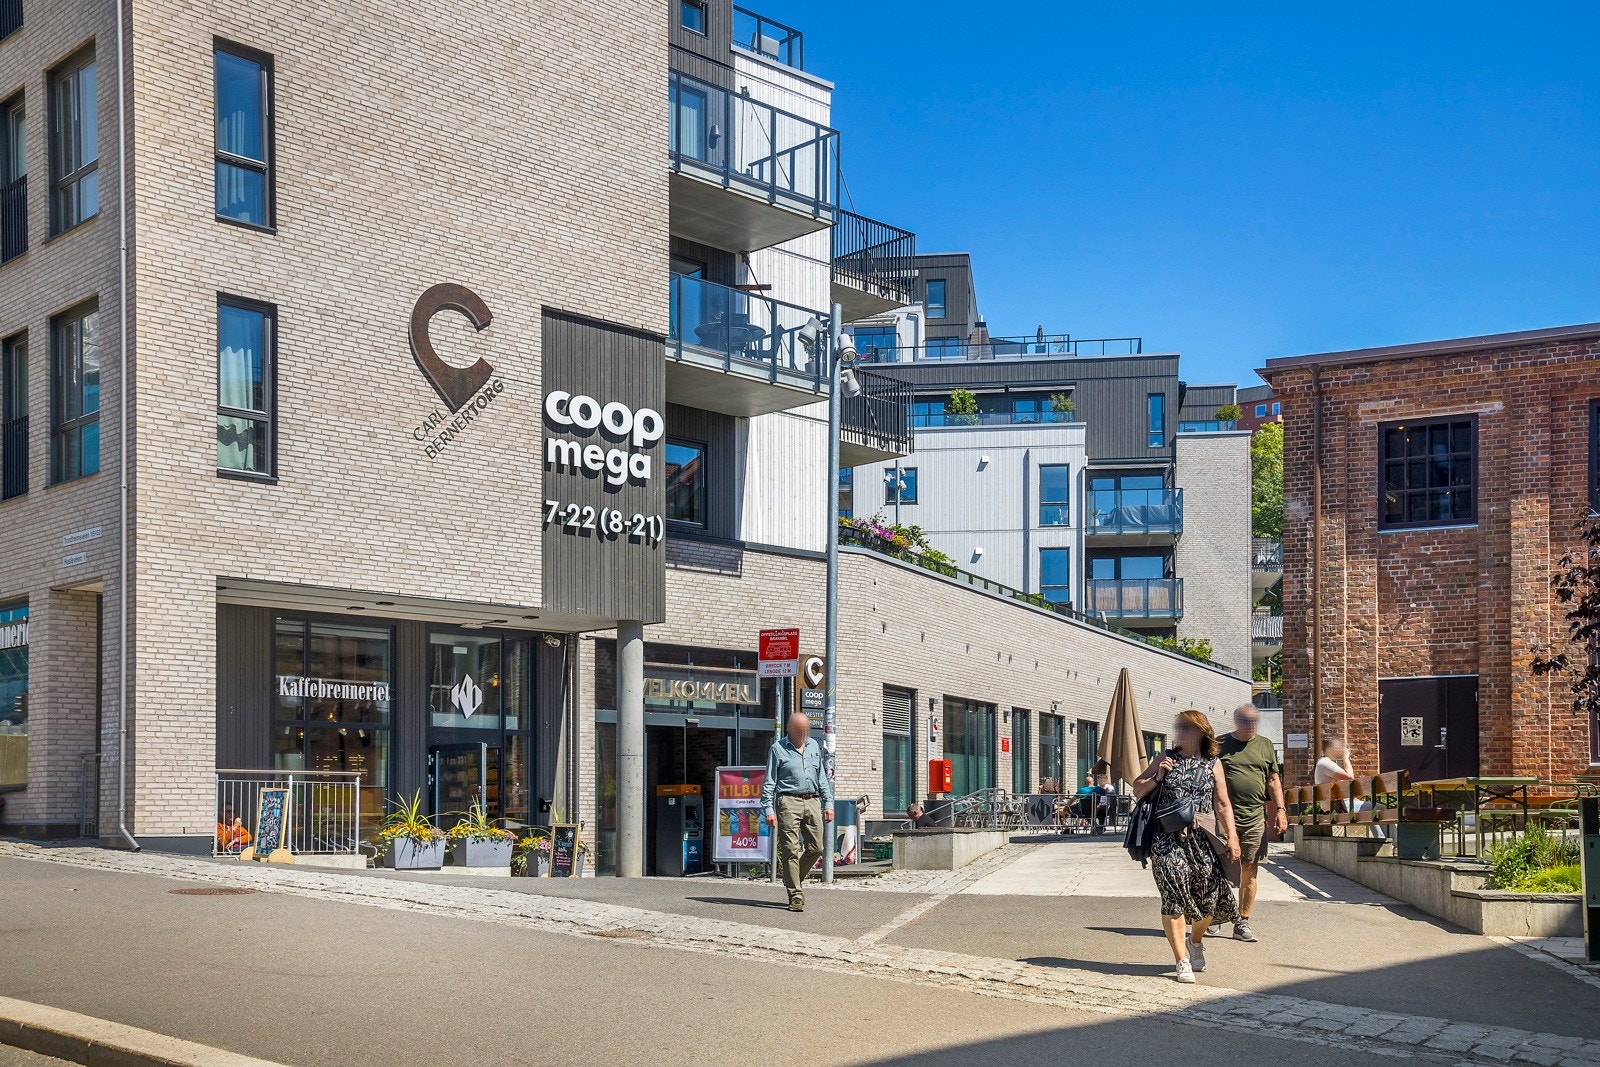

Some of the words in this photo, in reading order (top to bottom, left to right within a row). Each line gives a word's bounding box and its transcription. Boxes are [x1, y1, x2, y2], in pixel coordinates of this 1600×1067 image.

[413, 409, 447, 441] CARL
[424, 379, 504, 459] BERNERTORG
[545, 390, 664, 447] coop
[547, 437, 651, 486] mega
[545, 499, 596, 529] 7-22
[600, 506, 664, 542] (8-21)
[279, 676, 391, 702] Kaffebrenneriet
[805, 691, 824, 700] coop
[805, 699, 822, 707] mega
[720, 784, 761, 797] TILBU
[733, 837, 757, 847] -40%
